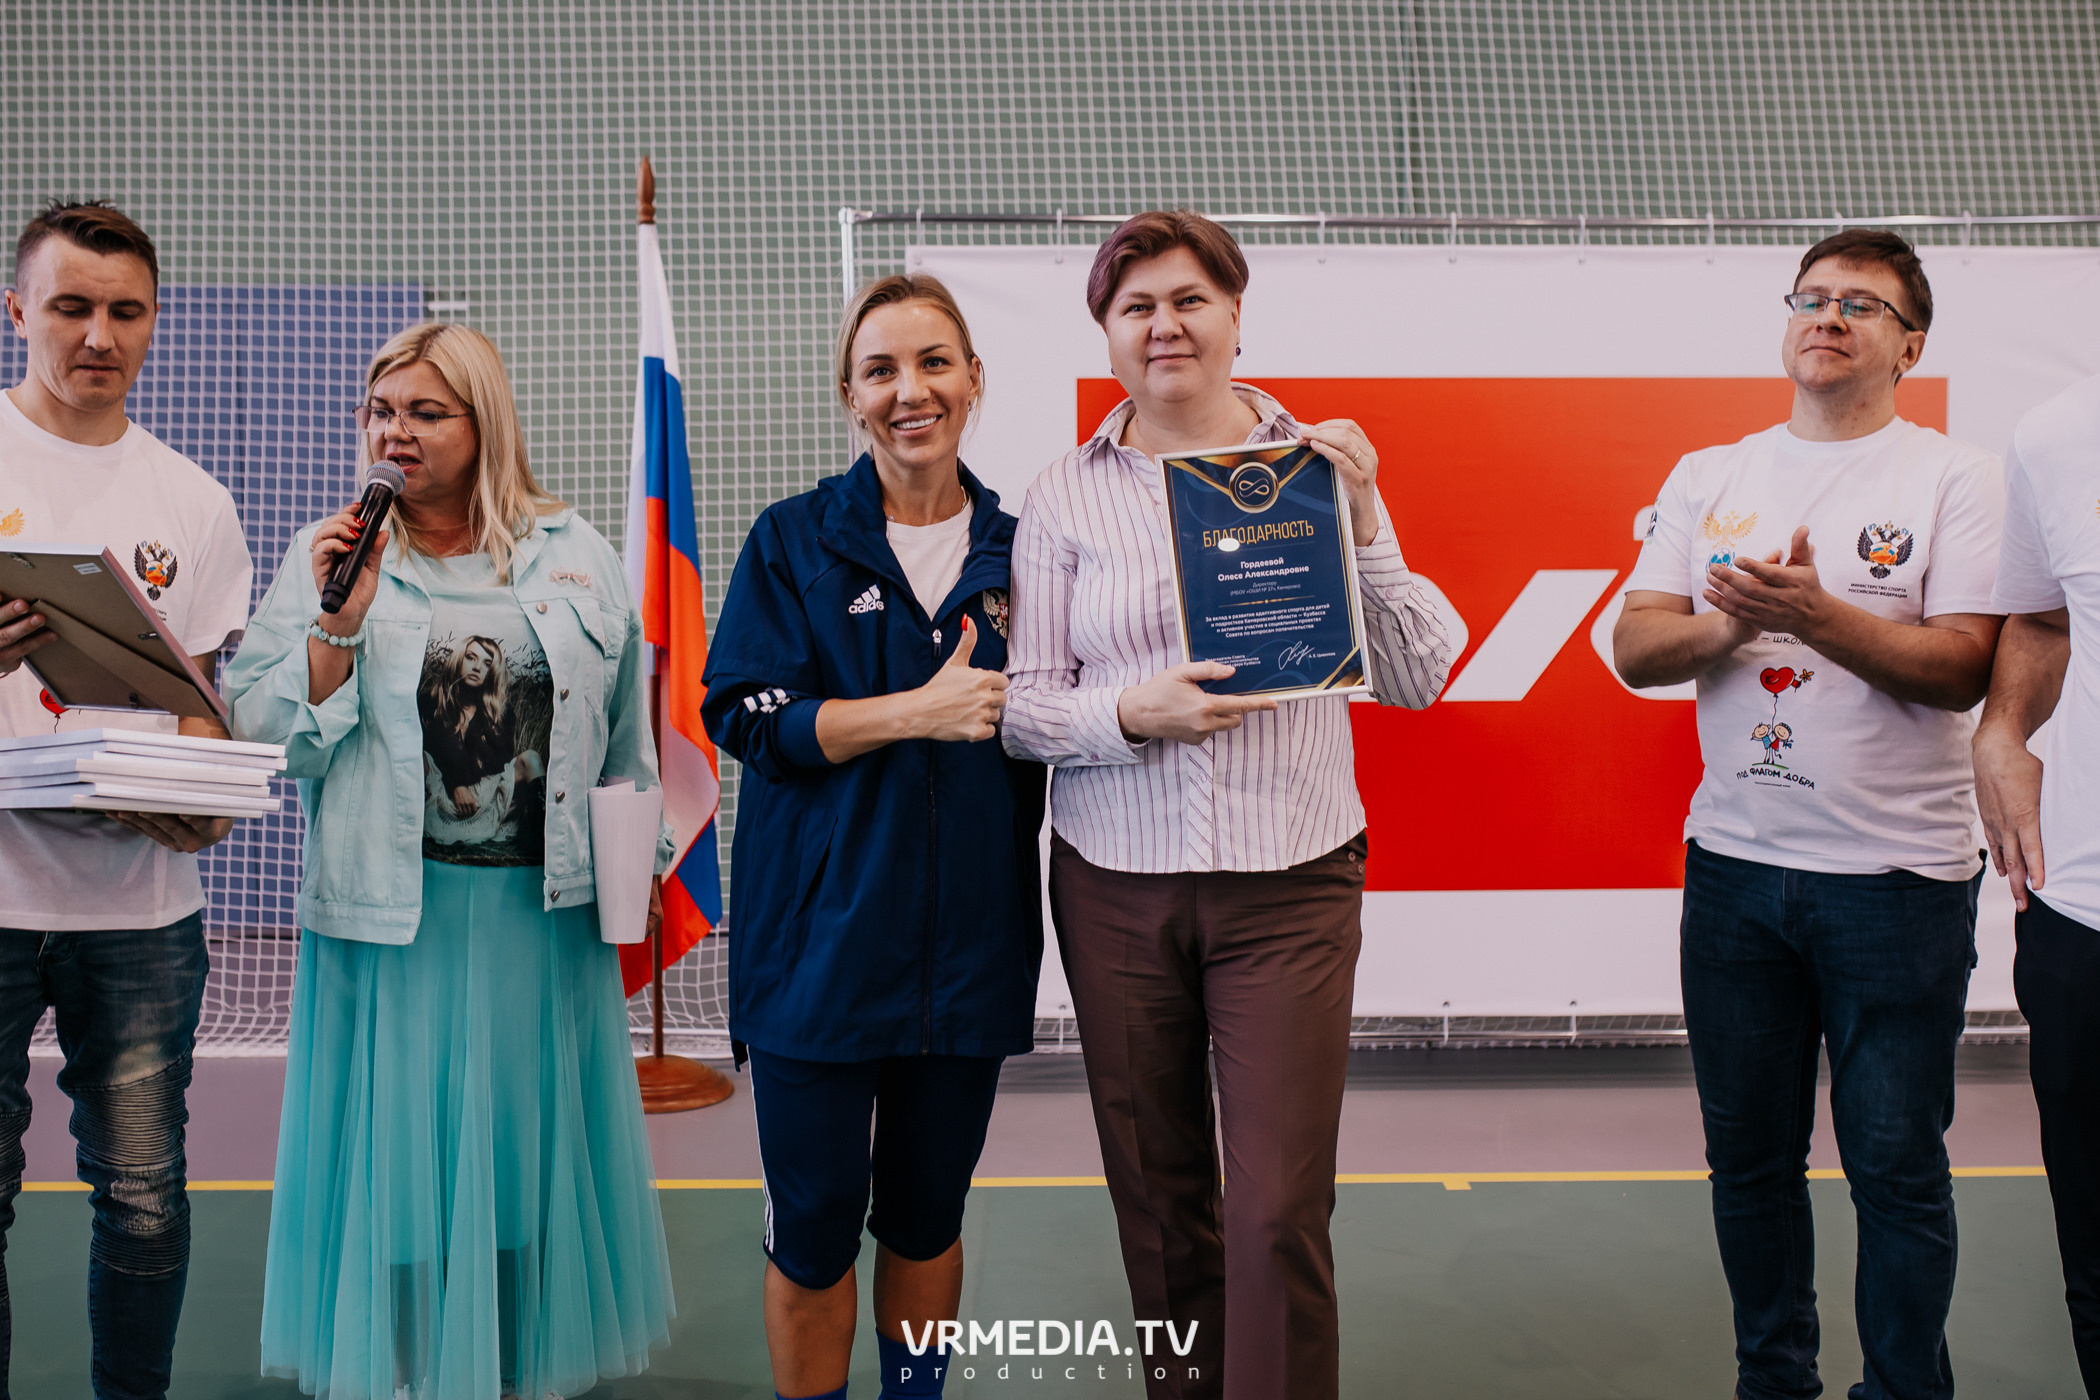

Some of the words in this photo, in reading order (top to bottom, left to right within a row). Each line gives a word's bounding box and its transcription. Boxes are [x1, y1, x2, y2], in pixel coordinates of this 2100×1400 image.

[1202, 520, 1315, 549] БЛАГОДАРНОСТЬ
[1240, 557, 1284, 570] Гордеевой
[1217, 572, 1243, 582] Олесе
[1244, 565, 1310, 579] Александровне
[1287, 606, 1305, 615] спорта
[1772, 635, 1805, 646] ШКОЛ
[1736, 769, 1749, 780] ПОД
[1749, 767, 1781, 779] ФЛАГОМ
[1782, 772, 1815, 790] ДОБРА
